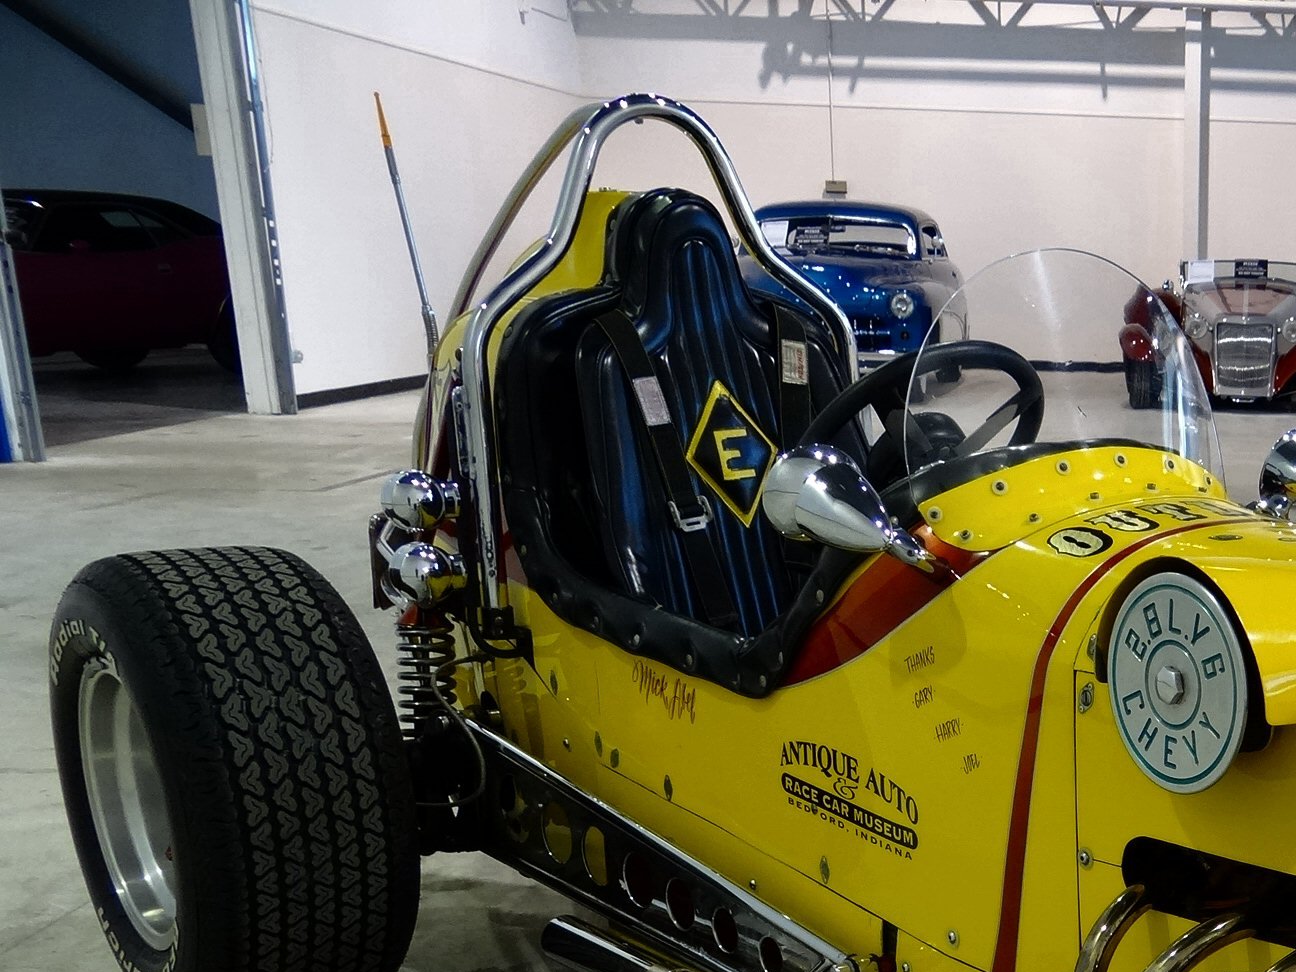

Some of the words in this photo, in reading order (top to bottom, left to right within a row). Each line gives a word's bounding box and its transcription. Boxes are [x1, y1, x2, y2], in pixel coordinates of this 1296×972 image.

[713, 428, 756, 480] E
[904, 645, 935, 674] THANKS
[1122, 689, 1221, 770] CHEVY
[780, 741, 860, 783] ANTIQUE
[865, 767, 919, 825] AUTO
[785, 776, 819, 803] RACE
[822, 794, 849, 818] CAR
[853, 808, 914, 846] MUSEUM
[832, 777, 858, 800] &
[788, 797, 850, 833] BEDORD,
[855, 828, 913, 860] INDIANA
